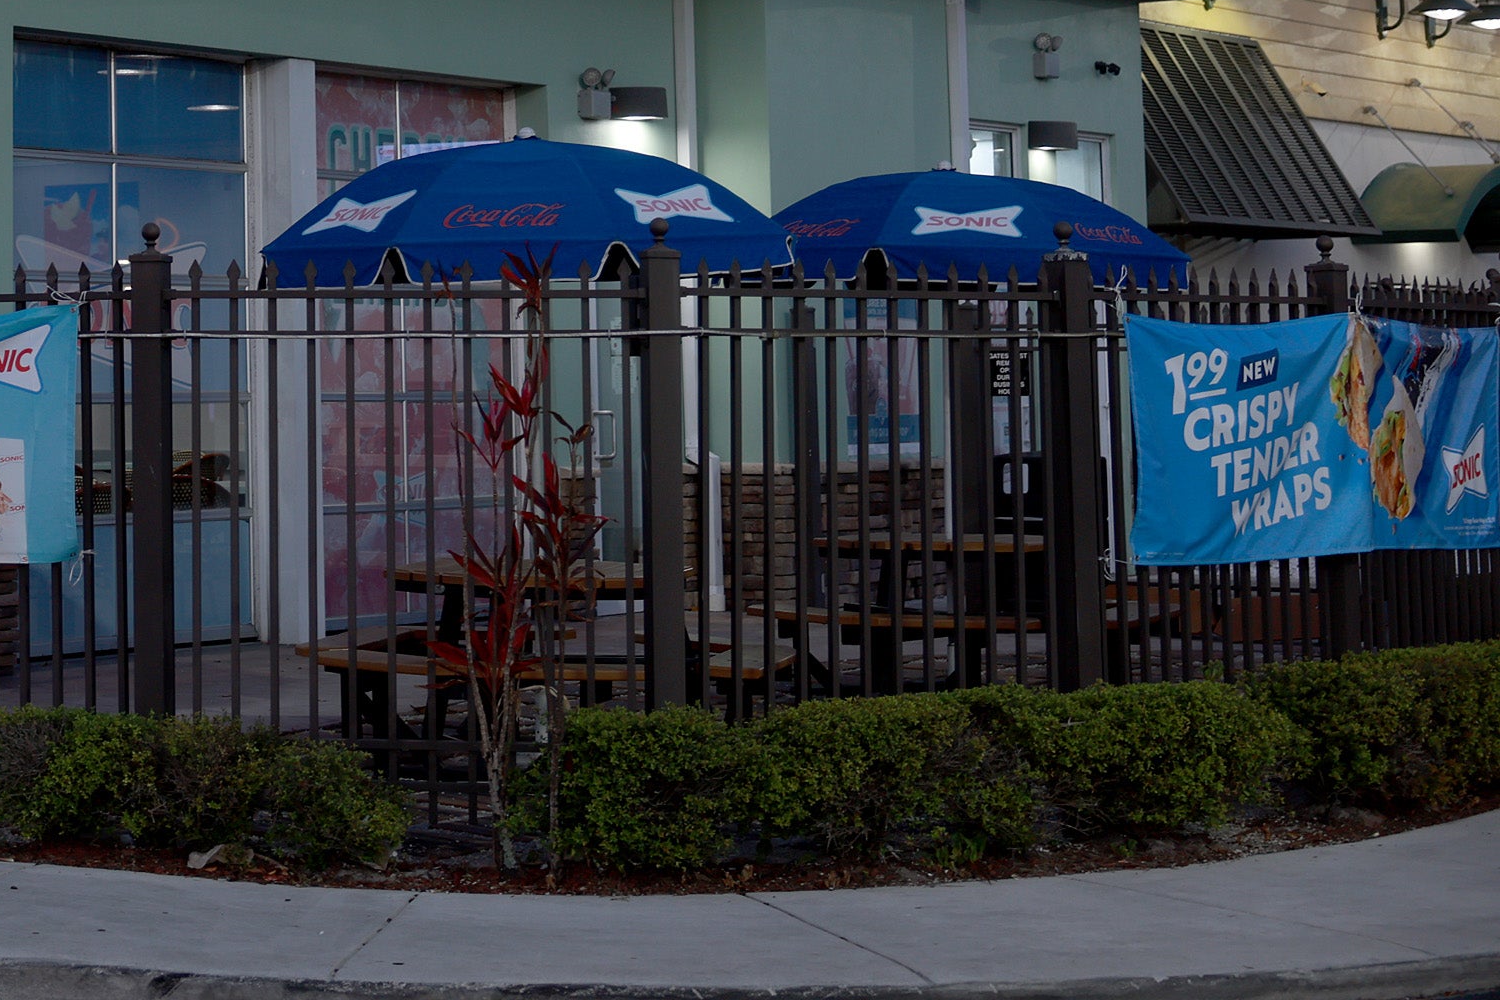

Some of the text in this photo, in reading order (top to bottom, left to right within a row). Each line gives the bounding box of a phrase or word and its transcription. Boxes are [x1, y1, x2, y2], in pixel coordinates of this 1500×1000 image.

[324, 206, 391, 222] SONIC
[443, 203, 566, 228] Coca-Cola
[636, 198, 712, 213] SONIC
[927, 214, 1009, 228] SONIC
[1242, 357, 1276, 383] NEW
[1183, 382, 1300, 452] CRISPY
[1211, 421, 1319, 497] TENDER
[1452, 453, 1481, 489] SONIC
[1231, 466, 1332, 538] WRAPS
